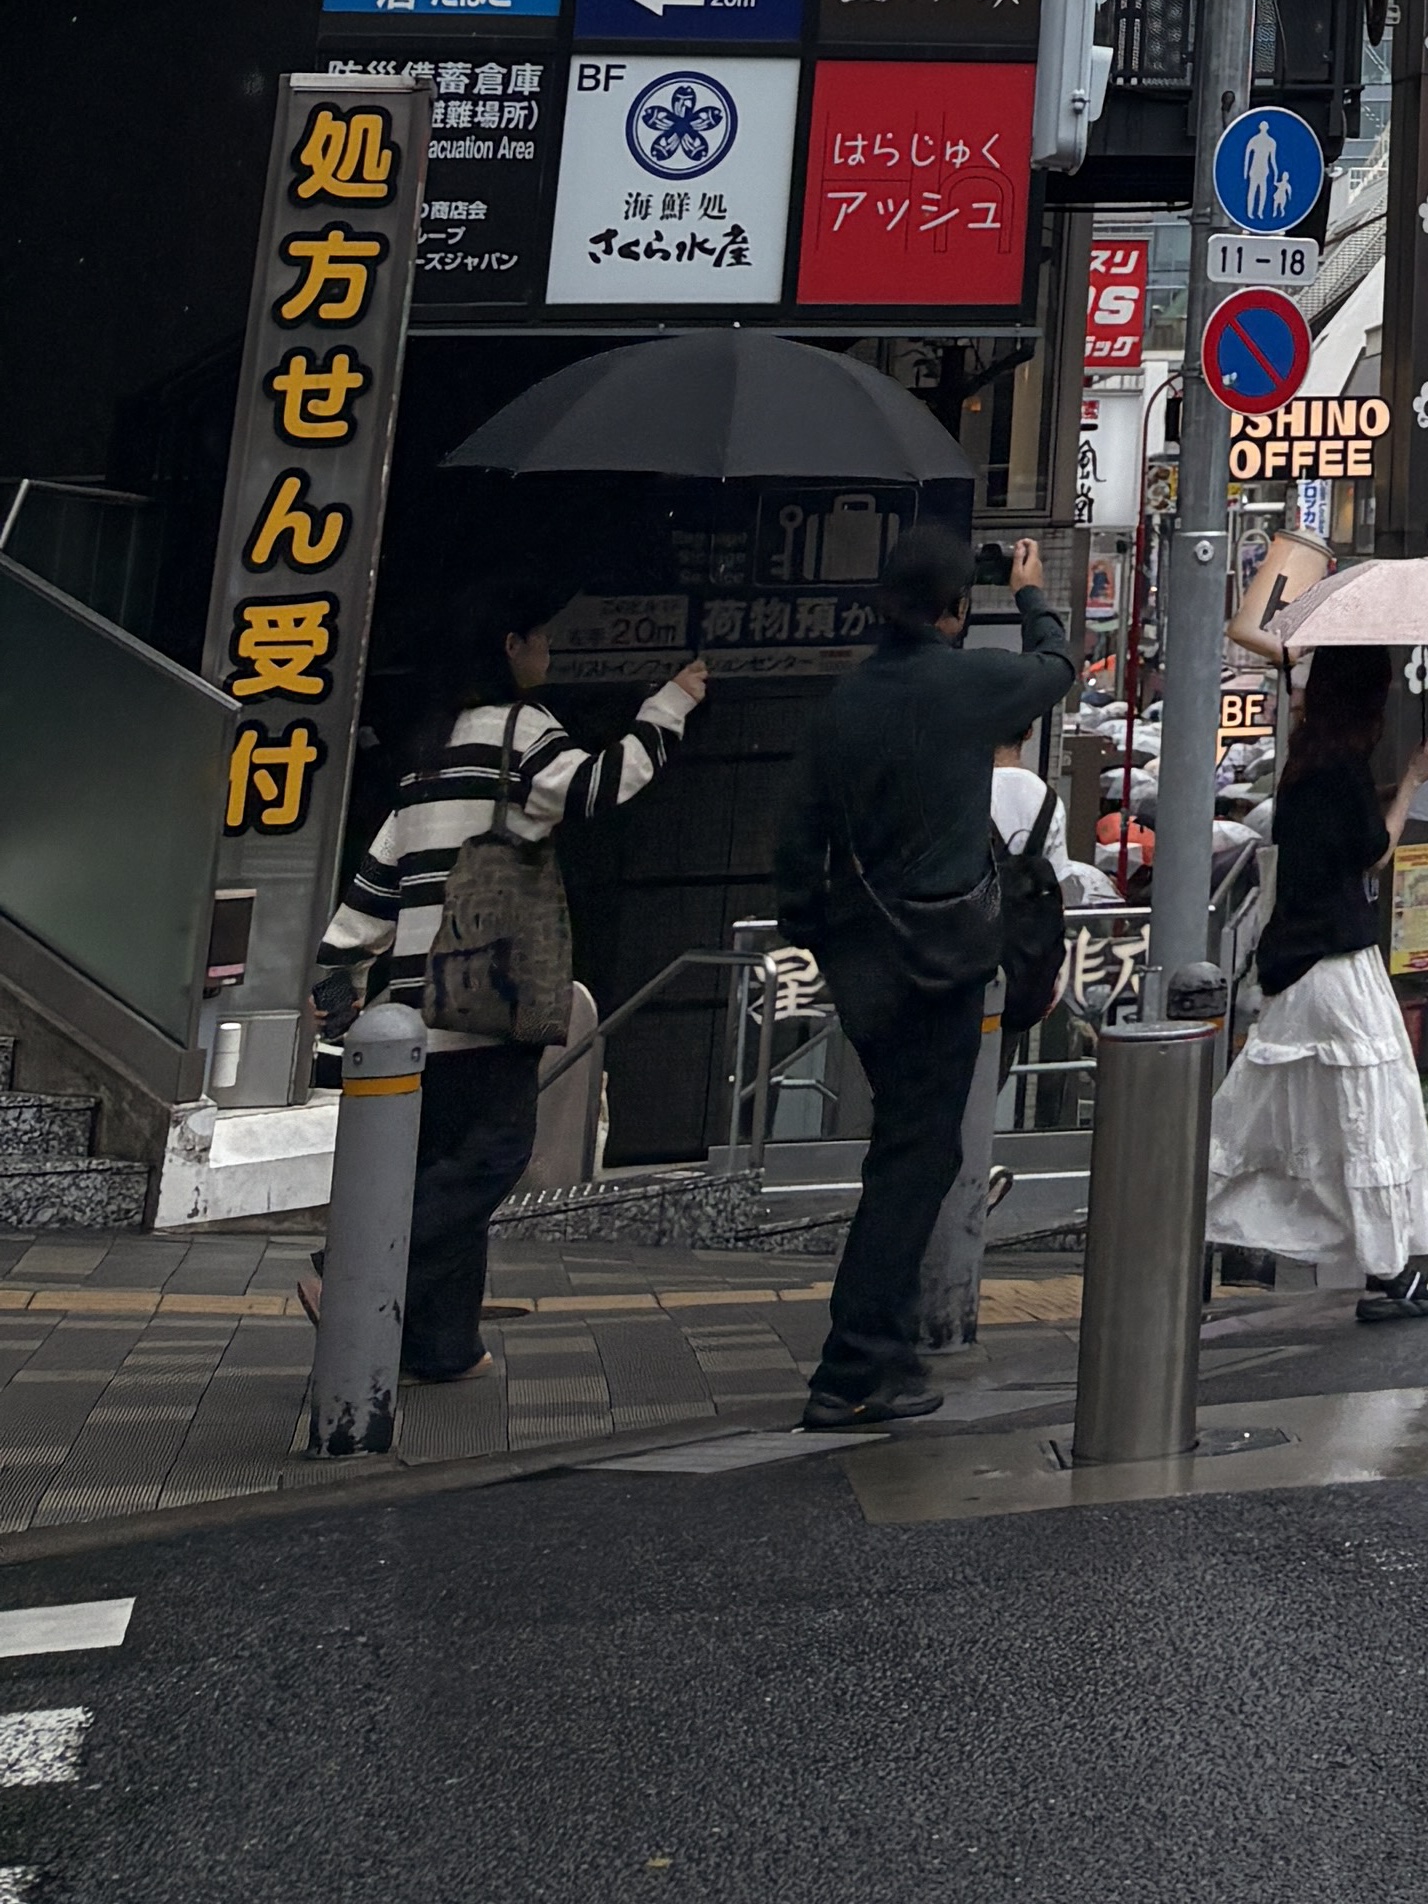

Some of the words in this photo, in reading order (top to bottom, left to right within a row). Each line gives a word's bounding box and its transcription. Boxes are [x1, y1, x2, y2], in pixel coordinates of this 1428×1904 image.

[577, 63, 627, 91] BF
[431, 100, 539, 130] 難場所)
[429, 136, 492, 159] acuation
[497, 136, 534, 159] Area
[833, 132, 1001, 168] はらじゅく
[420, 201, 488, 219] 商店会
[623, 192, 728, 221] 海鮮処
[826, 192, 1002, 232] アッシュ
[587, 225, 753, 269] さくら水産
[1231, 399, 1390, 438] SHINO
[226, 110, 391, 827] 処方せん受付
[1229, 440, 1373, 479] OFFEE
[611, 618, 676, 644] 20m
[703, 597, 880, 641] 荷物預か
[1222, 694, 1264, 727] BF
